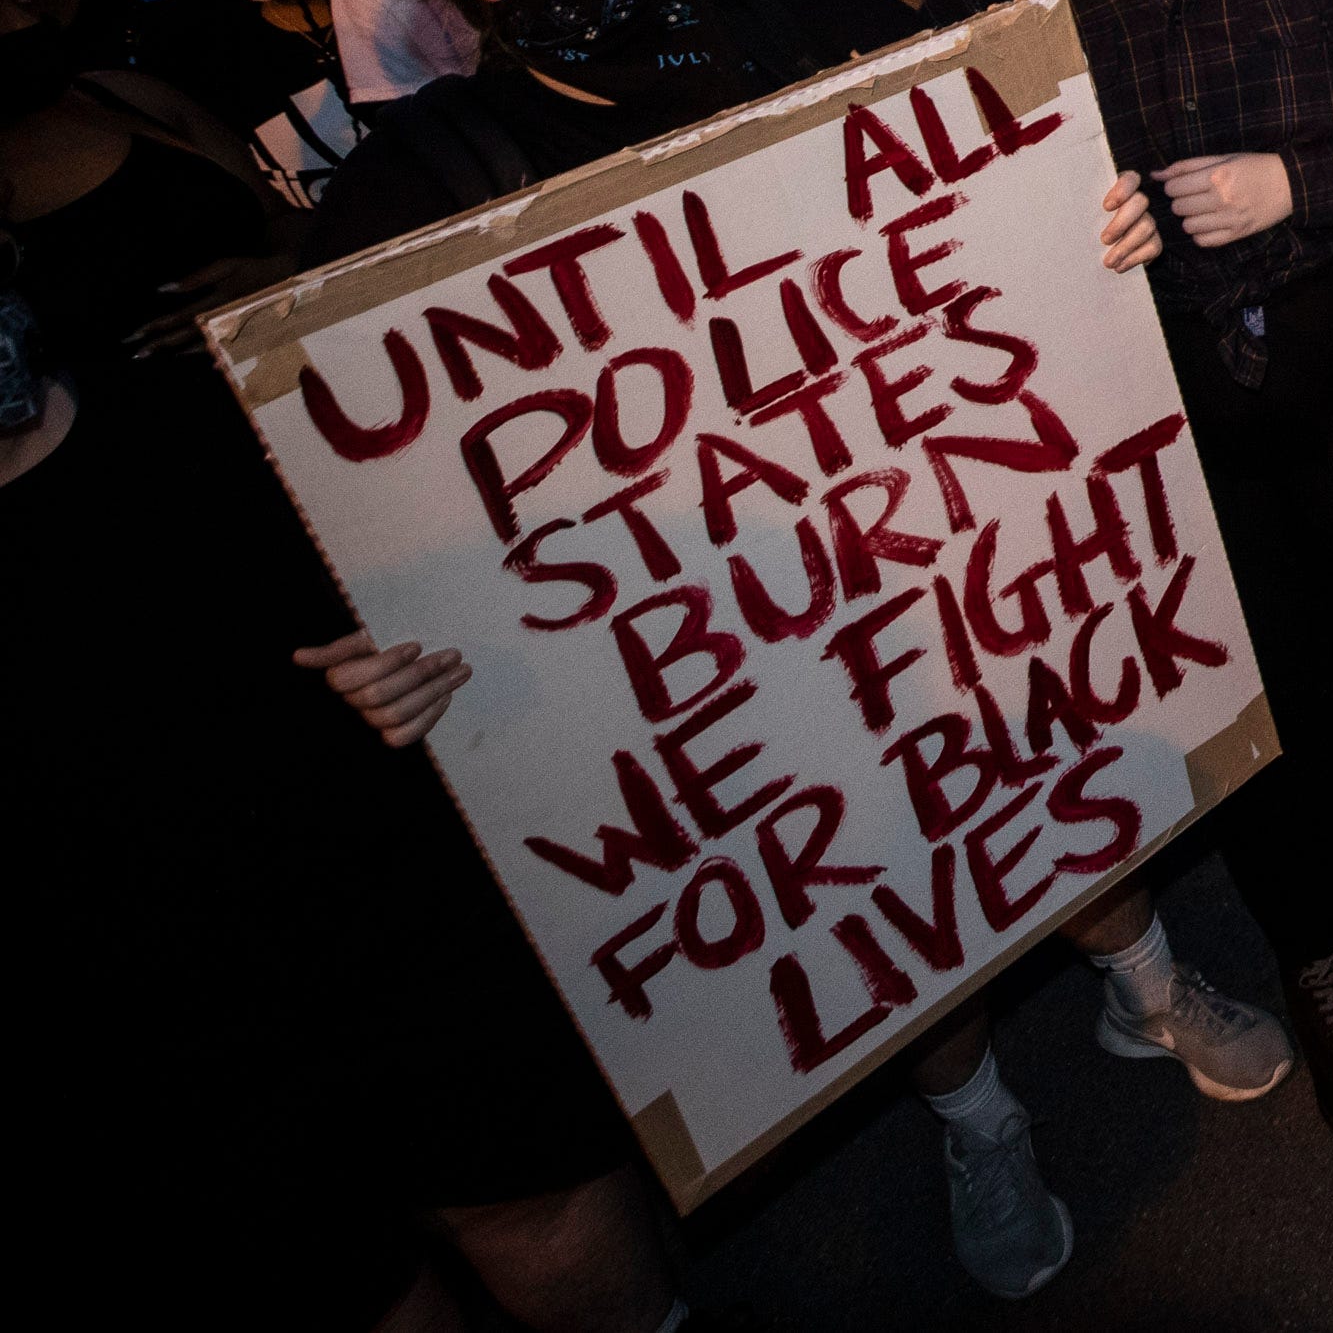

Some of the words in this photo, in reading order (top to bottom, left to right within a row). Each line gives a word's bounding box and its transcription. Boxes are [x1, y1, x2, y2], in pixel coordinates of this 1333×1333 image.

[300, 191, 800, 462] UNTIL
[846, 68, 1066, 220] ALL
[460, 193, 968, 538] POLICE
[503, 287, 1039, 631] STATES
[612, 391, 1079, 724] BURN
[526, 682, 768, 895] WE
[823, 415, 1186, 730] FIGHT
[592, 784, 886, 1017] FOR
[883, 558, 1229, 840] BLACK
[772, 748, 1140, 1073] LIVES
